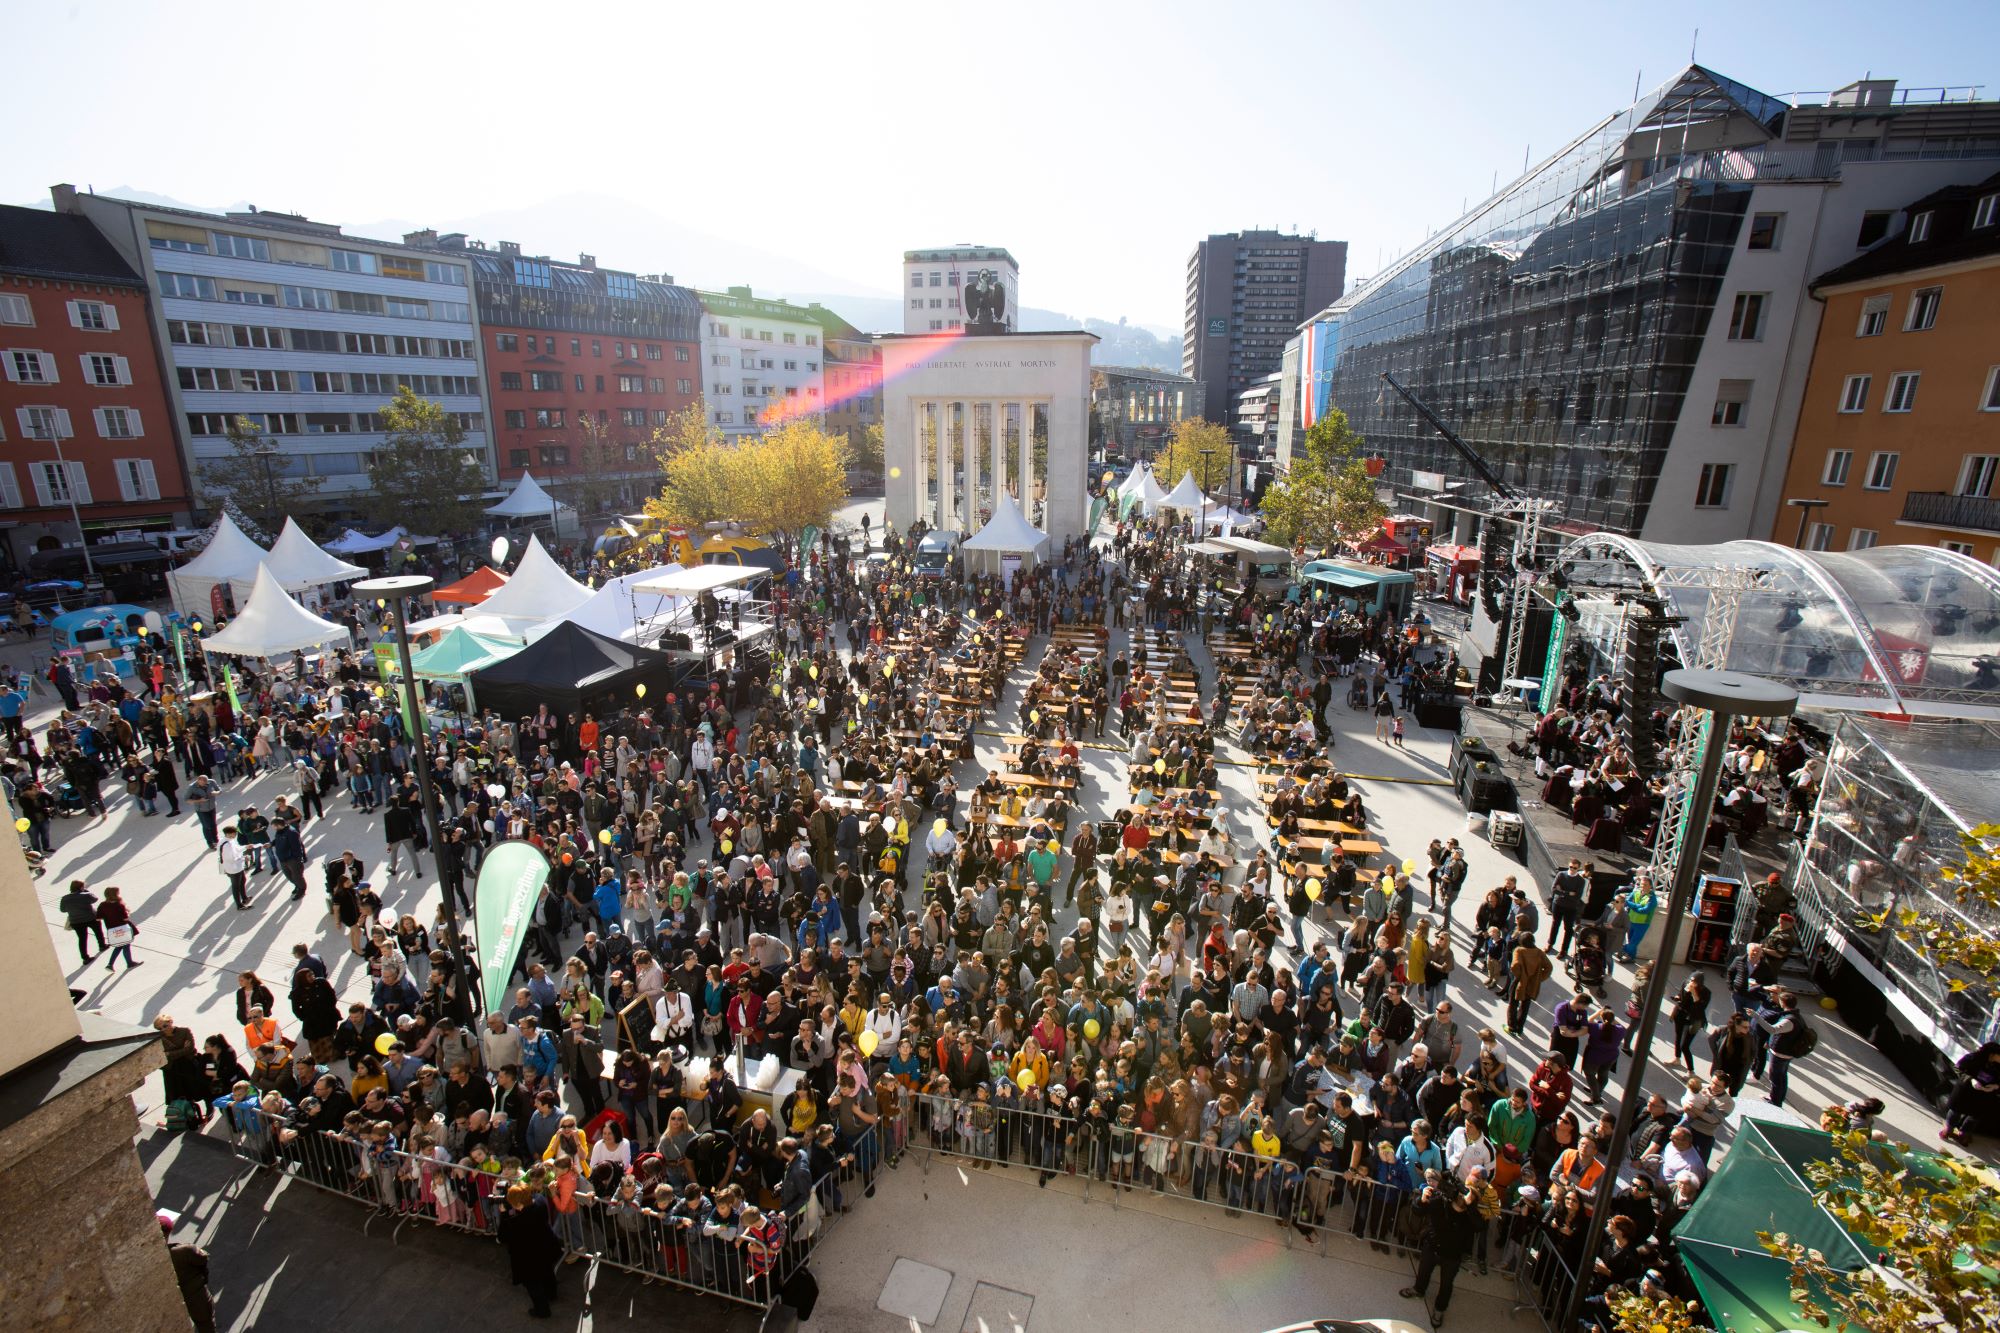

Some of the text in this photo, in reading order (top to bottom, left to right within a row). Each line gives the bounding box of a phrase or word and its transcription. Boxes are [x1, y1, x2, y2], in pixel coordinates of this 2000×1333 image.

[1210, 320, 1225, 328] AC
[927, 361, 967, 369] LIBERTATE
[974, 360, 1012, 368] AVSTRIAE
[1020, 360, 1057, 368] MORTVIS
[487, 858, 544, 970] Tiroler Tageszeitung
